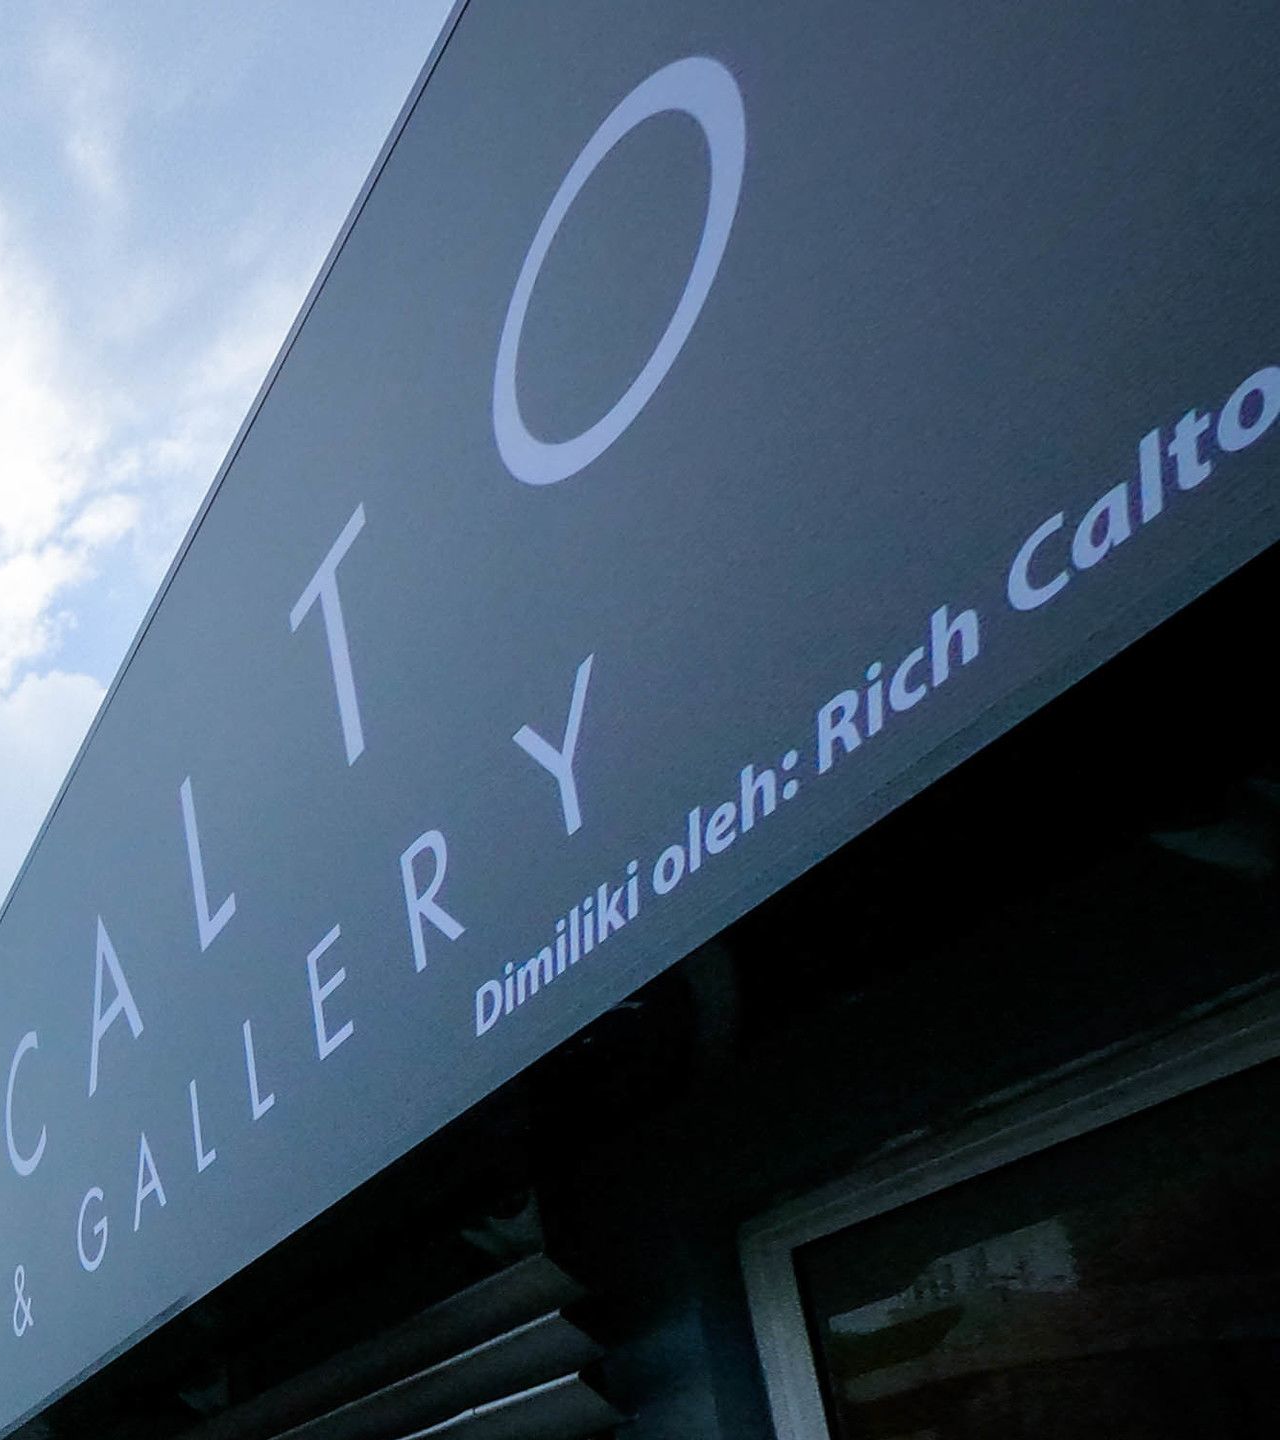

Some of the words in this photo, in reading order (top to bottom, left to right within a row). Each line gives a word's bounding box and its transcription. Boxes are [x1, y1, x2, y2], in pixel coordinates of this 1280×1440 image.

[13, 1264, 34, 1337] &
[77, 652, 595, 1272] GALLERY
[475, 859, 640, 1038] Dimiliki
[652, 749, 800, 896] oleh:
[817, 603, 981, 775] Rich
